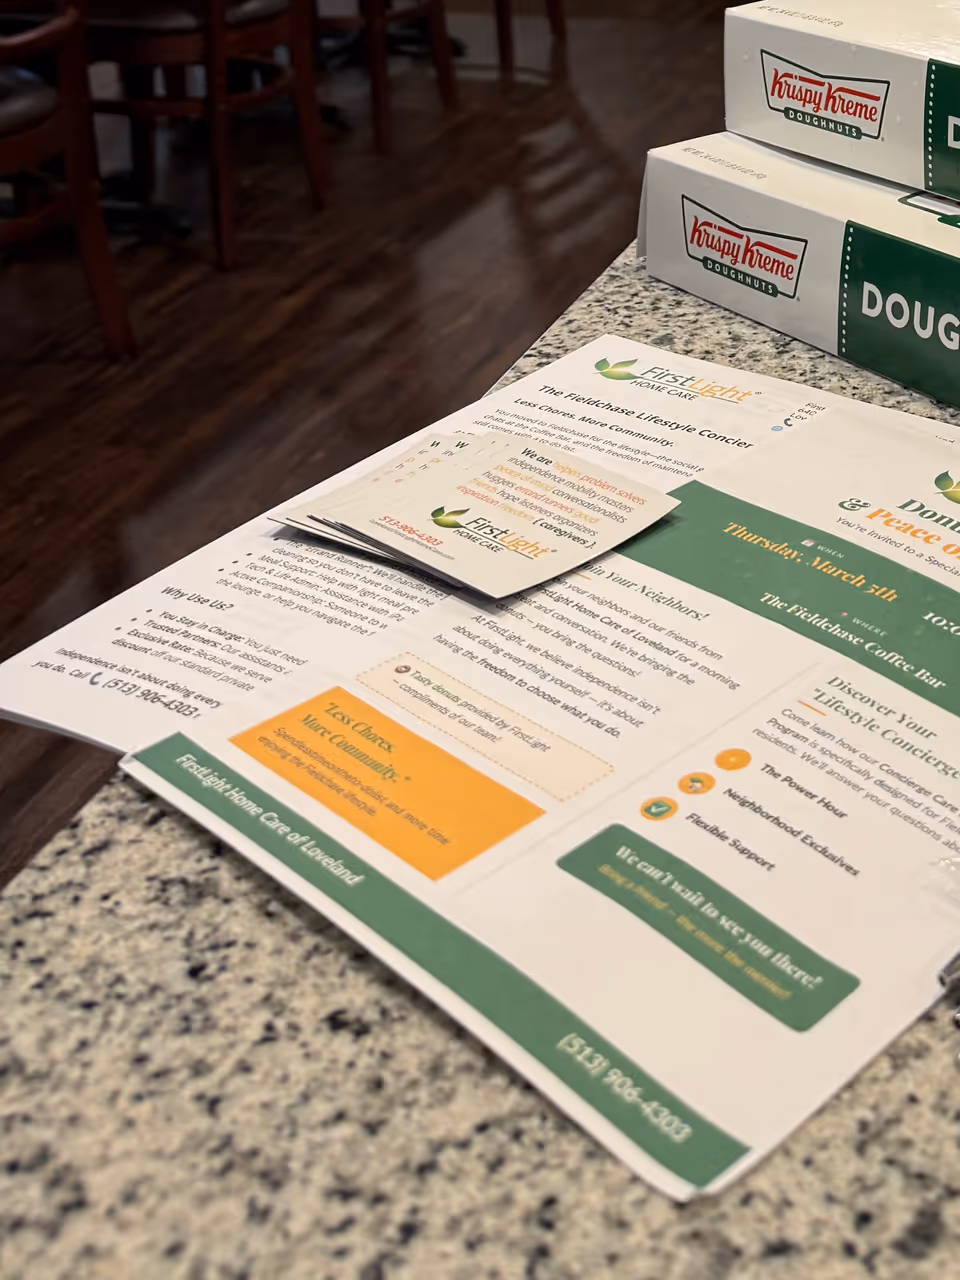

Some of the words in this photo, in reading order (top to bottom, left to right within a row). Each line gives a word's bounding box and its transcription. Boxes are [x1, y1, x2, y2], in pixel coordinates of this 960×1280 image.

[770, 68, 826, 113] Krispy
[824, 82, 881, 122] Kreme
[789, 110, 857, 137] DOUGHNUTS
[689, 215, 744, 265] Krispy
[742, 234, 798, 281] Kreme
[706, 259, 776, 296] DOUGHNUTS
[630, 380, 662, 394] HOME
[662, 386, 699, 401] CARE
[640, 366, 752, 402] FirstLight
[514, 397, 539, 412] Less
[539, 404, 577, 422] Chores.
[577, 414, 607, 429] More
[607, 419, 674, 448] Community.
[538, 385, 563, 400] The
[562, 391, 635, 417] Fieldchase
[636, 411, 697, 434] Lifestyle
[508, 457, 565, 483] independence
[565, 478, 600, 501] mobility
[599, 494, 634, 513] masters
[522, 447, 537, 461] We
[536, 454, 553, 466] are
[580, 473, 616, 494] problem
[615, 488, 647, 505] solvers
[551, 486, 628, 524] conversationalists
[551, 509, 598, 537] organizers
[838, 497, 871, 511] &
[866, 507, 941, 546] Peace
[379, 515, 444, 547] 513-906-4303
[453, 528, 479, 544] HOME
[477, 537, 504, 553] CARE
[466, 516, 551, 559] FirstLight
[540, 521, 589, 544] caregivers
[816, 543, 845, 559] WHEN
[836, 516, 866, 535] You're
[866, 528, 902, 548] Invited
[902, 543, 916, 553] to
[915, 550, 924, 559] a
[722, 521, 803, 562] Thursday,
[805, 555, 867, 588] March
[865, 584, 899, 603] 5th
[160, 585, 188, 603] Why
[188, 593, 210, 607] Use
[209, 599, 235, 612] Us?
[604, 569, 635, 590] Your
[636, 584, 710, 622] Neighbors!
[759, 592, 789, 610] The
[787, 603, 865, 646] Fieldchase
[864, 641, 915, 672] Coffee
[913, 667, 947, 690] Bar
[851, 617, 888, 637] WHERE
[811, 687, 881, 732] "Lifestyle
[826, 676, 897, 718] Discover
[896, 713, 939, 741] Your
[760, 763, 780, 779] The
[780, 775, 818, 802] Power
[816, 796, 848, 820] Hour
[175, 753, 228, 795] FirstLight
[224, 786, 264, 816] Home
[260, 811, 291, 835] Care
[286, 829, 308, 846] of
[300, 838, 365, 888] Loveland
[685, 812, 731, 843] Flexible
[727, 837, 776, 872] Support
[722, 787, 802, 839] Neighborhood
[799, 833, 861, 877] Exclusives
[556, 1033, 611, 1077] (513)
[602, 1067, 693, 1143] 906-4303
